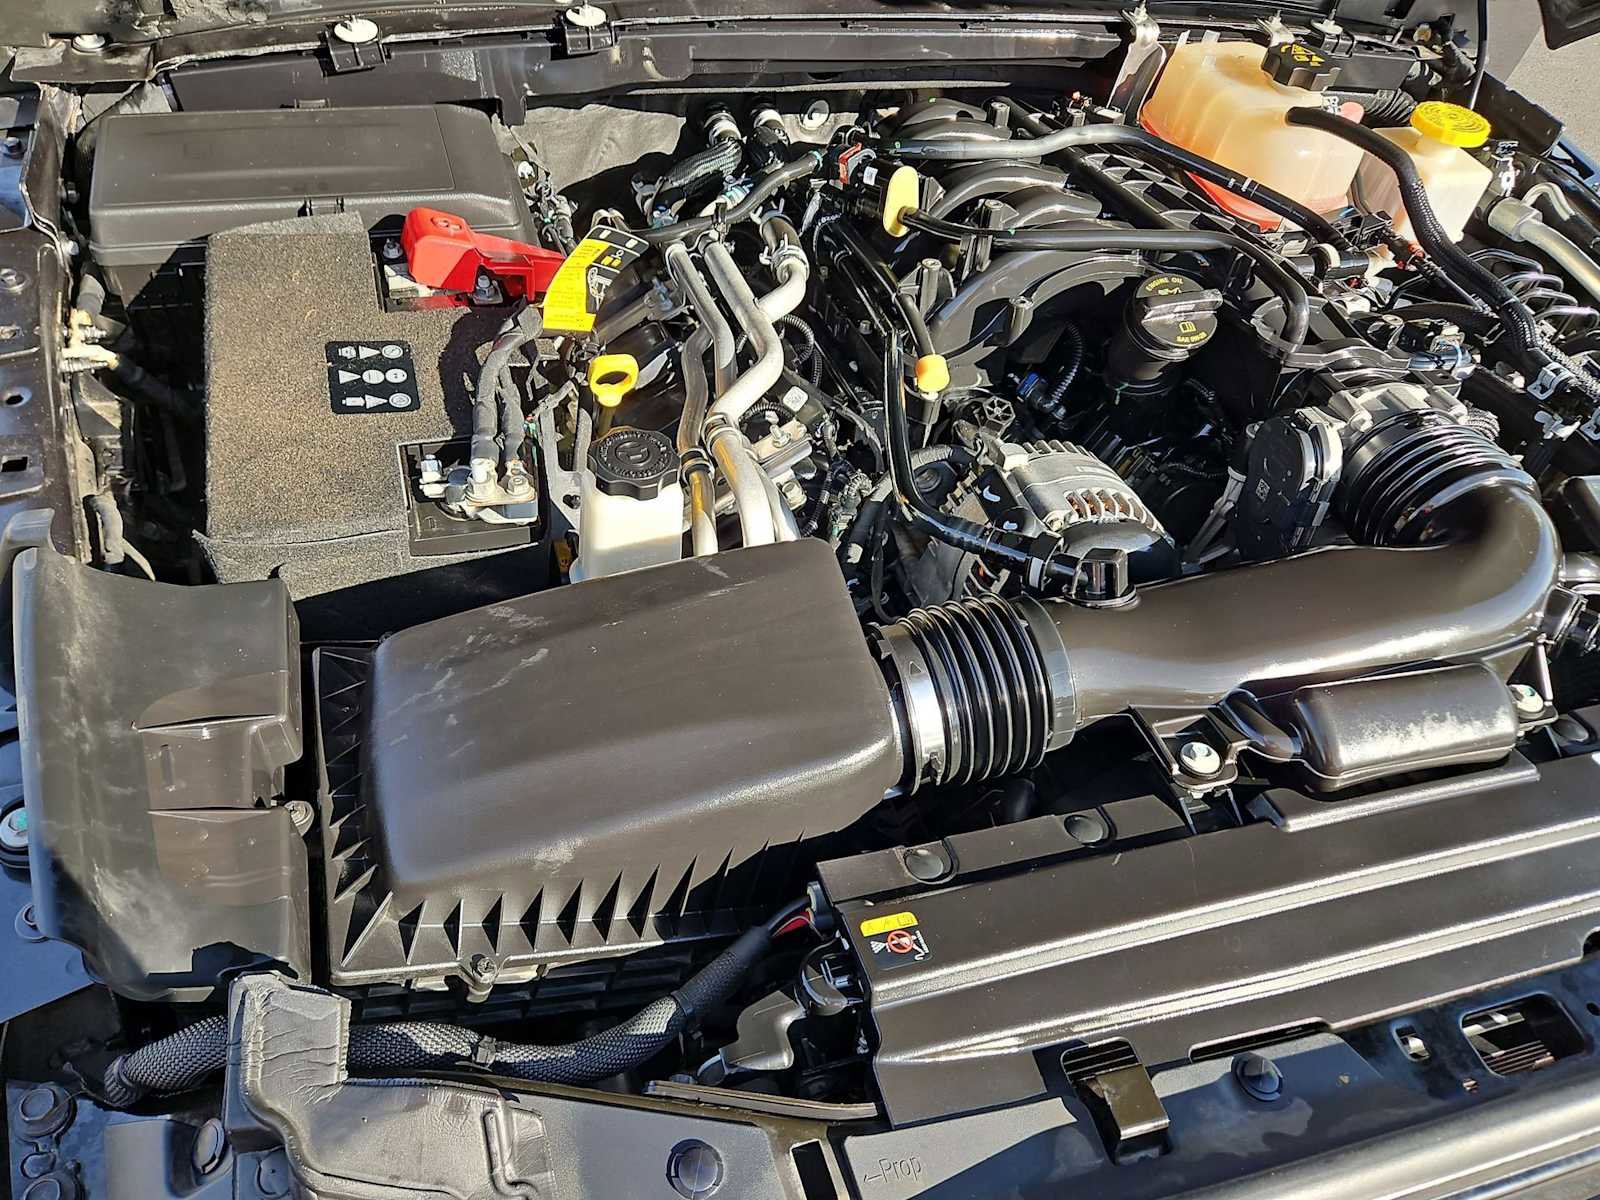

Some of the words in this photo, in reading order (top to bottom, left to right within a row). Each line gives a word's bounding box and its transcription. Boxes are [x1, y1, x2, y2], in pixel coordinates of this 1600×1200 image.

[1145, 277, 1169, 291] ENGINE
[1171, 276, 1184, 285] OIL
[879, 1157, 921, 1183] Prop
